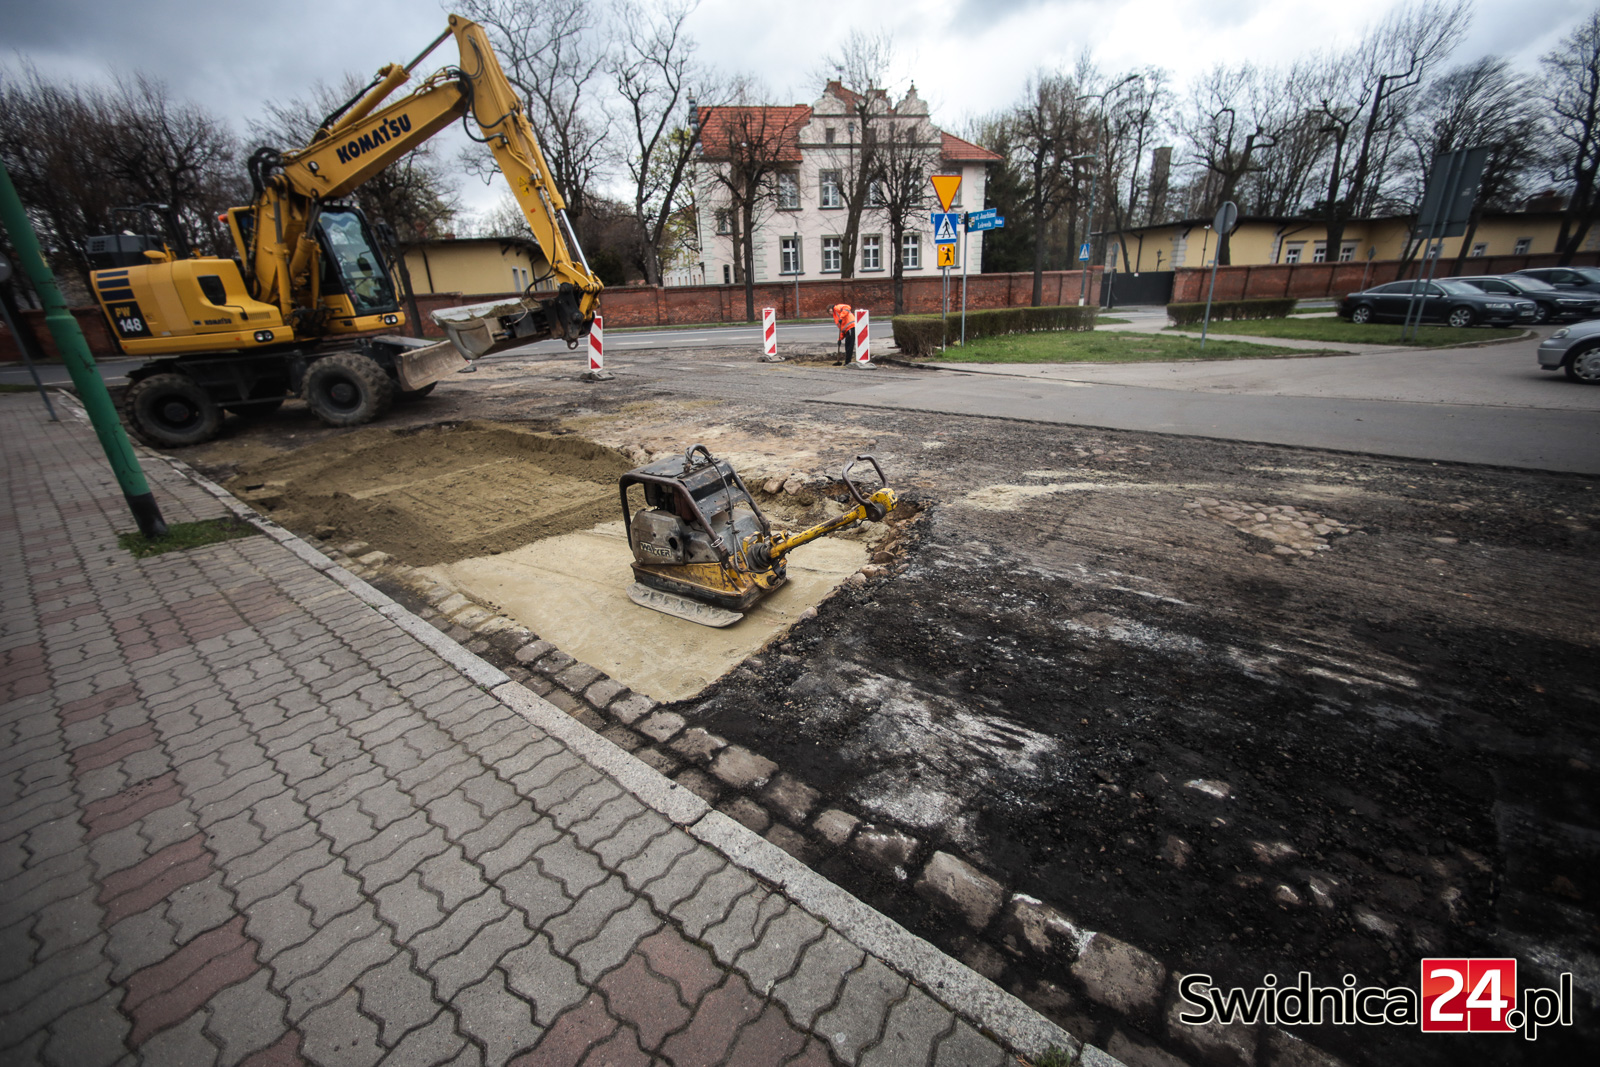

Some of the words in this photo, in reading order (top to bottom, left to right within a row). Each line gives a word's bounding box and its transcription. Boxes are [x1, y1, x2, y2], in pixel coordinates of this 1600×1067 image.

[336, 113, 411, 164] KOMATSU
[115, 307, 131, 317] PW
[120, 318, 142, 332] 148
